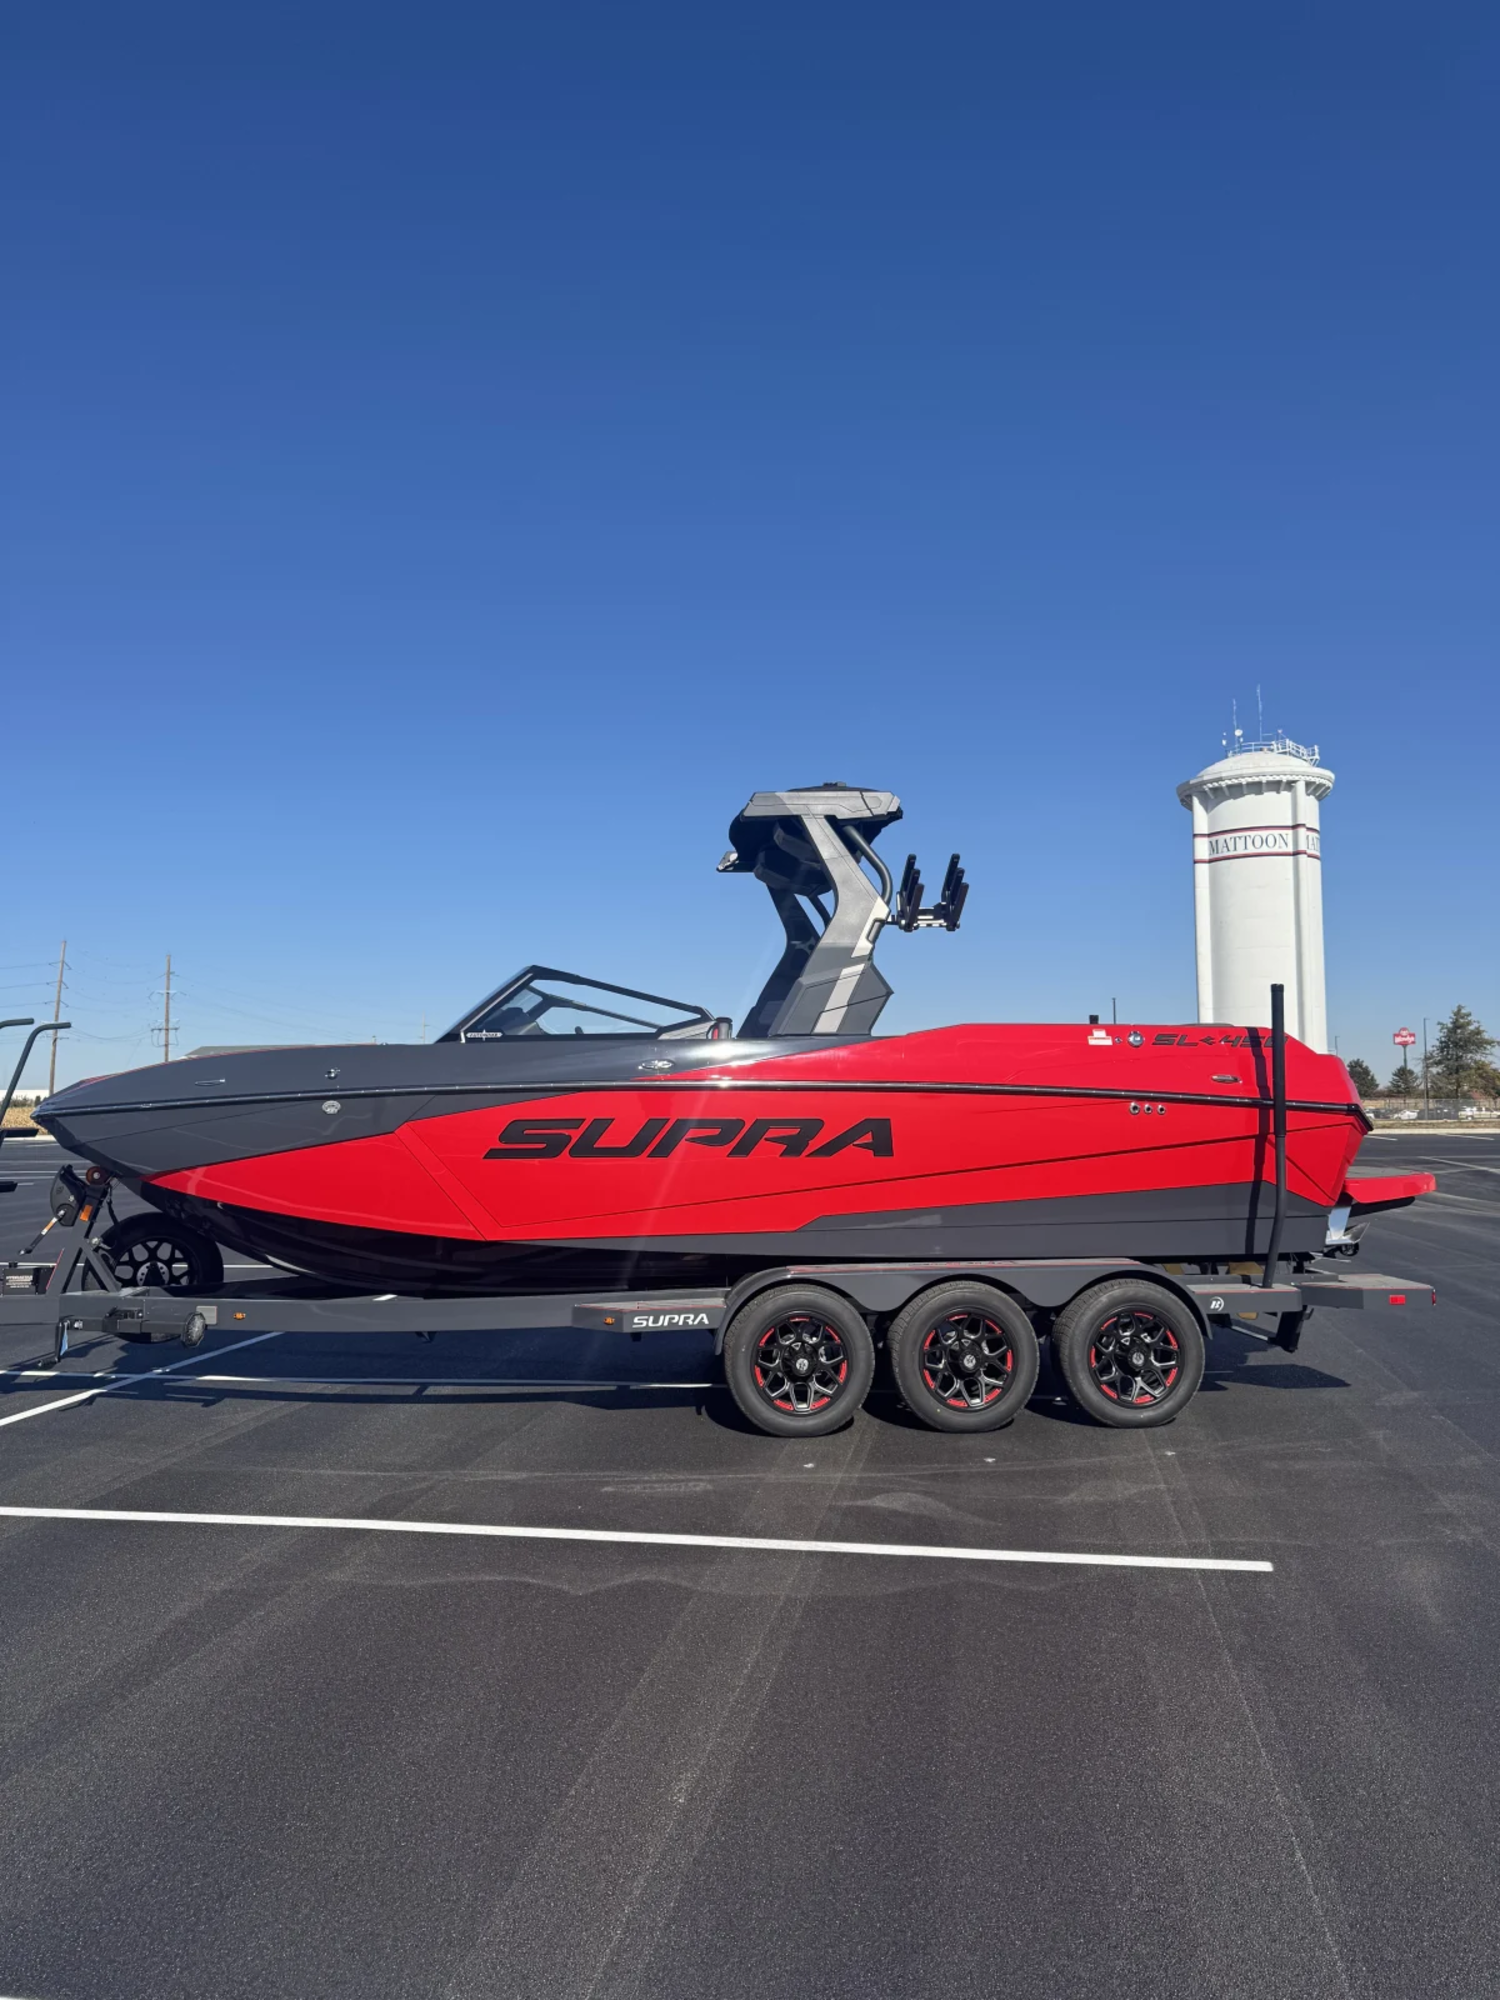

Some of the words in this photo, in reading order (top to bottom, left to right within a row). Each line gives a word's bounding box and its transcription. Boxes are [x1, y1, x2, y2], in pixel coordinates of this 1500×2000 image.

[1208, 833, 1289, 856] MATTOON
[1152, 1033, 1199, 1047] SL
[482, 1118, 894, 1160] SUPRA
[632, 1313, 709, 1328] SUPRA
